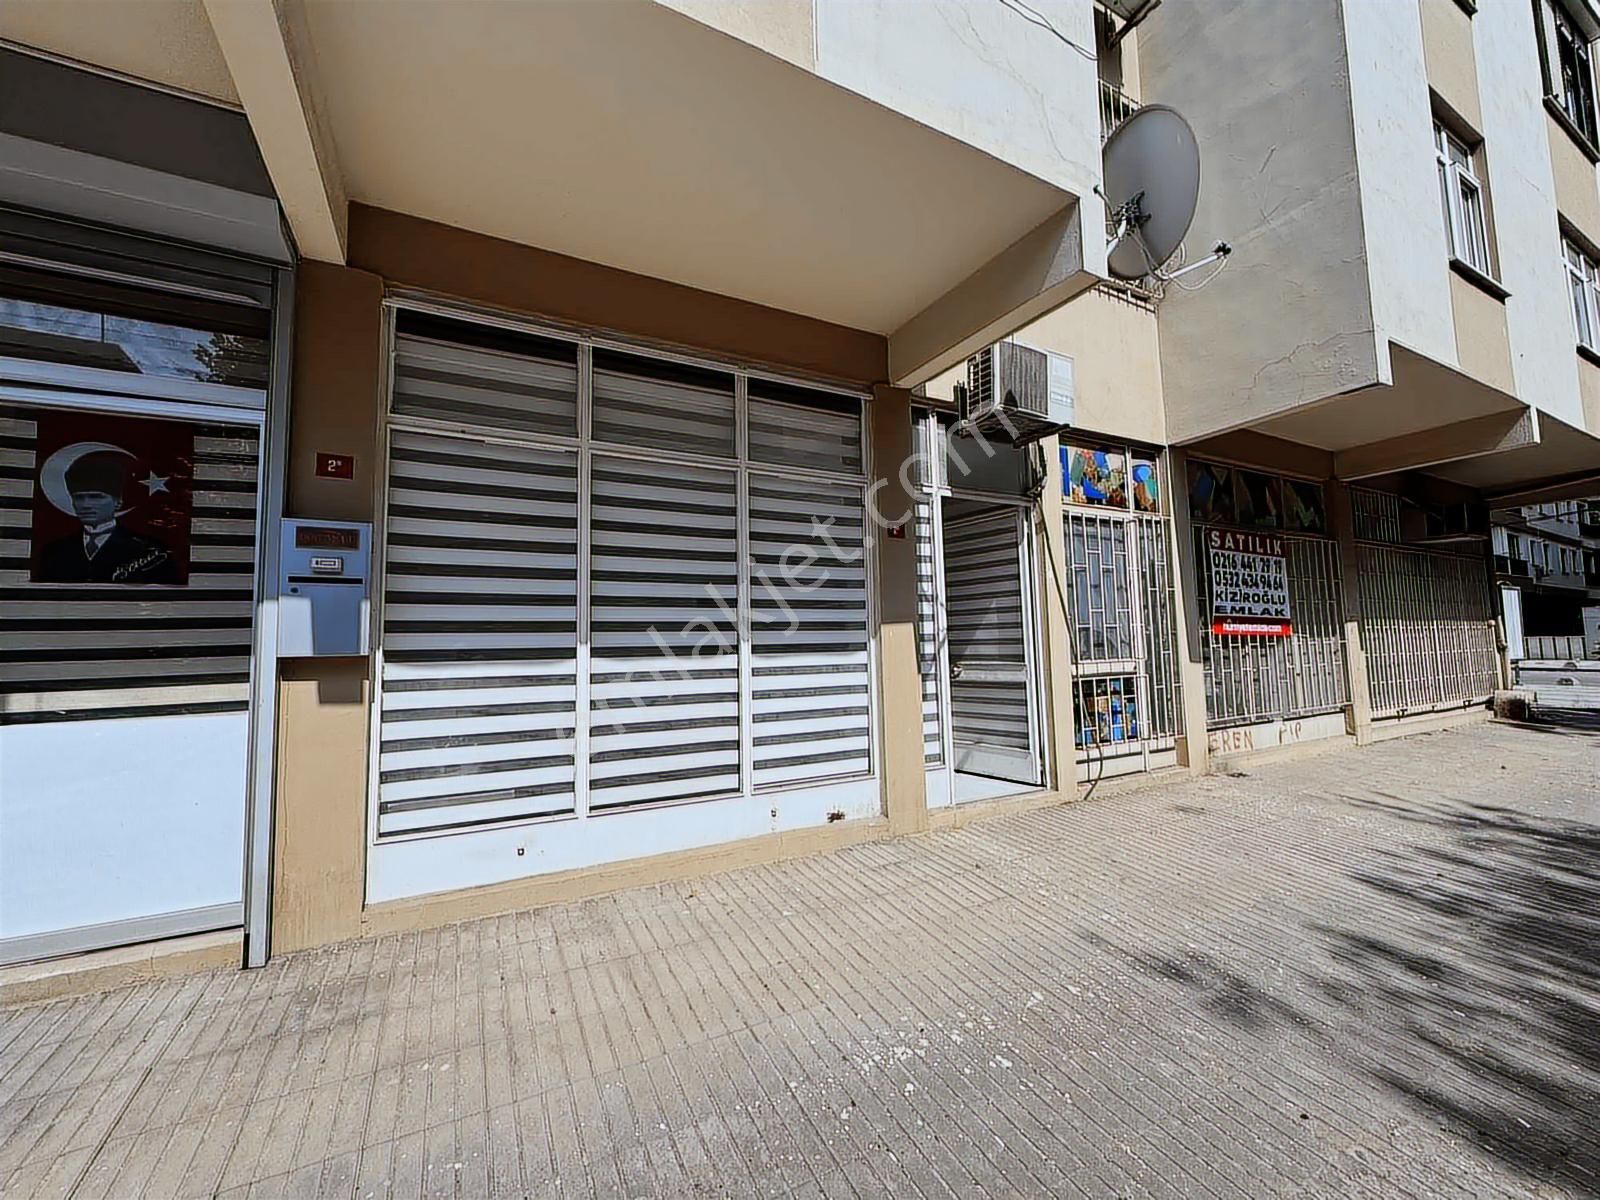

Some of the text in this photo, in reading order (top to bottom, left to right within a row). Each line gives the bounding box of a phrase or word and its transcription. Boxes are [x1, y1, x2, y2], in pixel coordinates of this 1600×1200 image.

[1211, 530, 1282, 556] SATILIK
[1212, 552, 1238, 571] 0216
[1214, 570, 1240, 588] 0532
[1215, 605, 1286, 617] EMLAK
